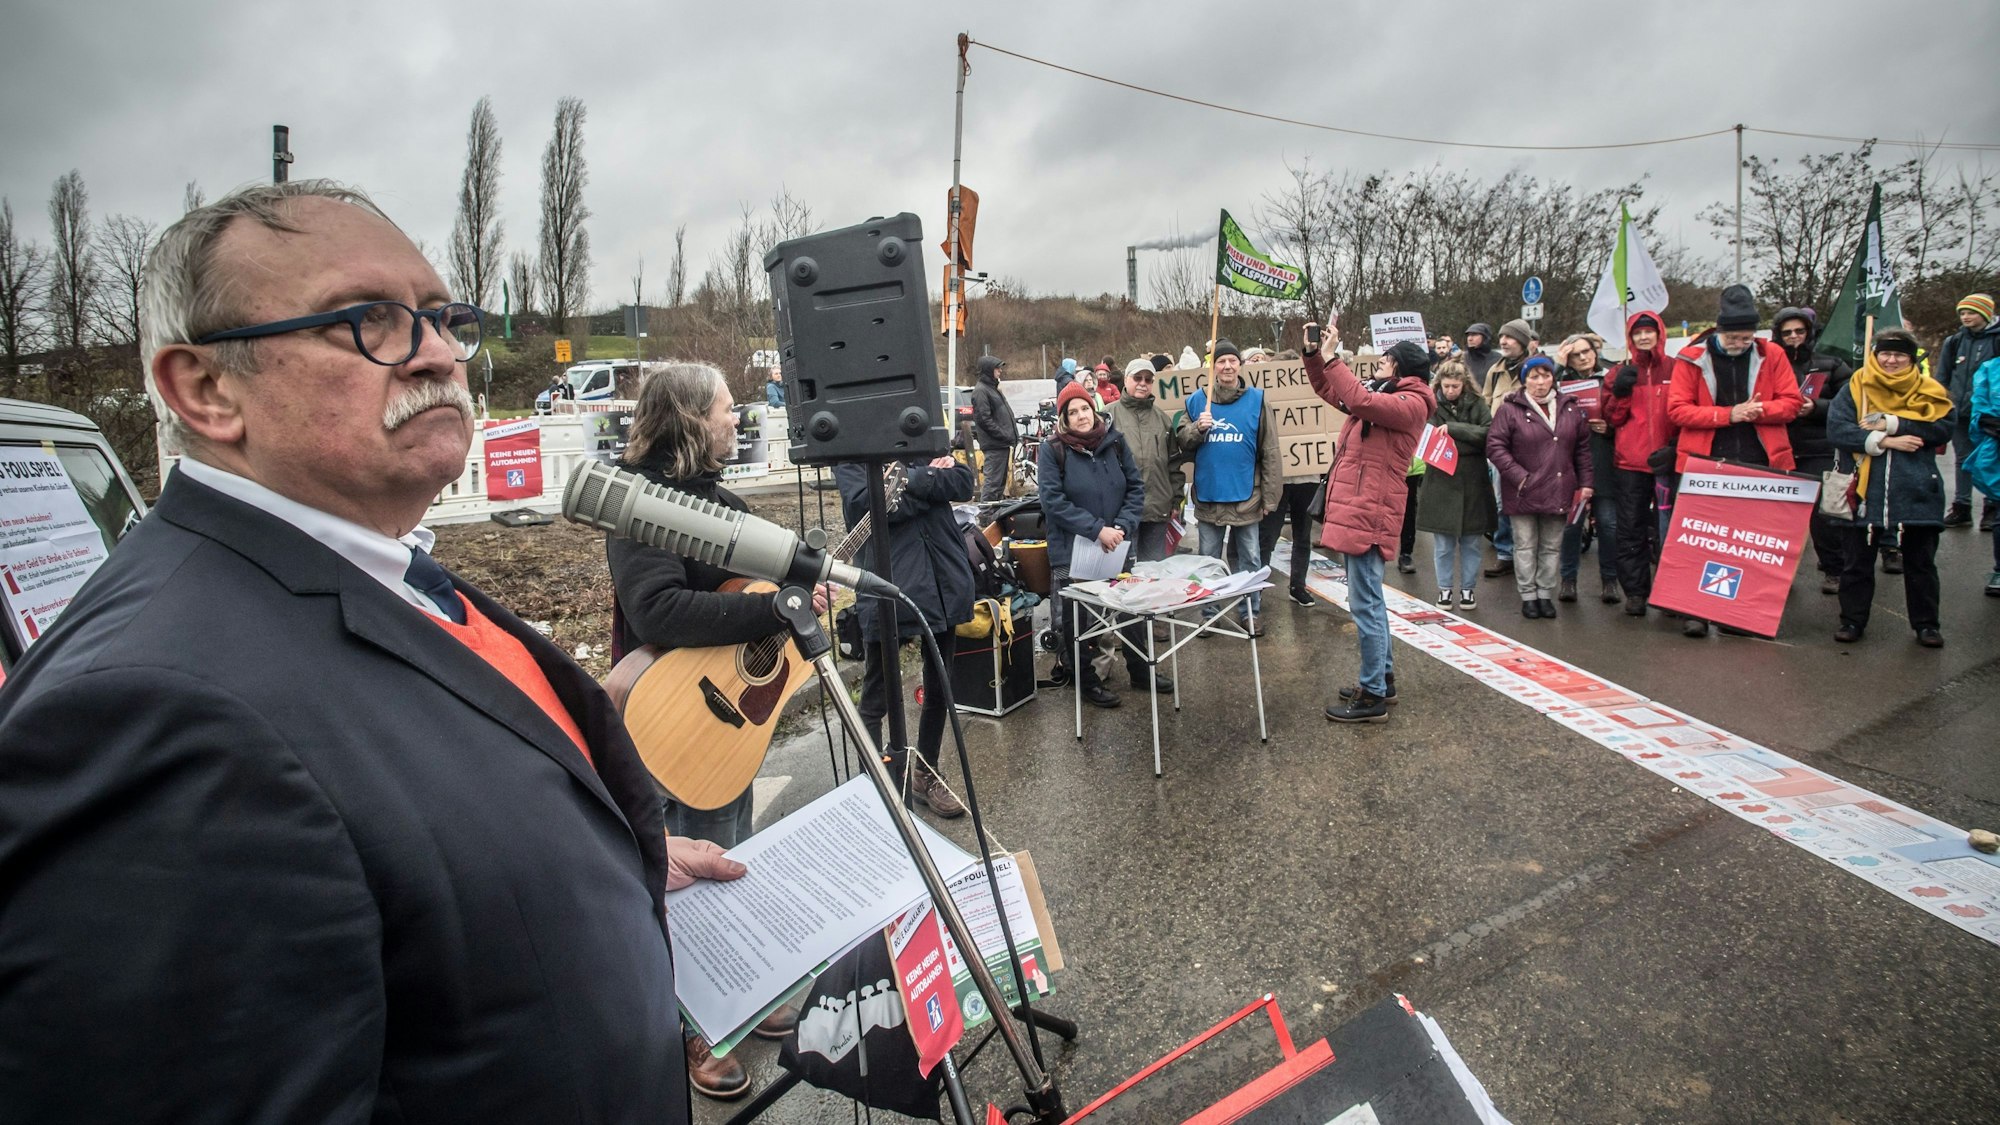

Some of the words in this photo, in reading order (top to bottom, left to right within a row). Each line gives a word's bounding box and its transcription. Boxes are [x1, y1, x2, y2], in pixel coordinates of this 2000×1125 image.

[1241, 267, 1286, 290] ASPHALT
[1246, 258, 1265, 271] UND
[1268, 267, 1296, 281] WALD
[1384, 316, 1415, 325] KEINE
[1158, 374, 1209, 400] MEG
[620, 415, 636, 425] BÜN
[1272, 405, 1323, 426] TATT
[1209, 433, 1243, 443] NABU
[490, 450, 512, 458] KEINE
[513, 449, 536, 457] NEUEN
[491, 457, 537, 467] AUTOBAHNEN
[2, 461, 63, 479] FOULSPIEL!
[1689, 480, 1718, 490] ROTE
[1723, 482, 1800, 495] KLIMAKARTE
[1681, 518, 1729, 537] KEINE
[1732, 530, 1789, 551] NEUEN
[1677, 533, 1784, 567] AUTOBAHNEN
[12, 563, 26, 572] Mehr
[26, 558, 39, 569] Geld
[964, 862, 1011, 882] FOULPIEL!
[903, 902, 925, 936] KLIMAKARTE
[905, 963, 922, 987] KEINE
[922, 947, 940, 969] NEUEN
[910, 962, 943, 1002] AUTOBAHNEN
[830, 1031, 853, 1055] Fender
